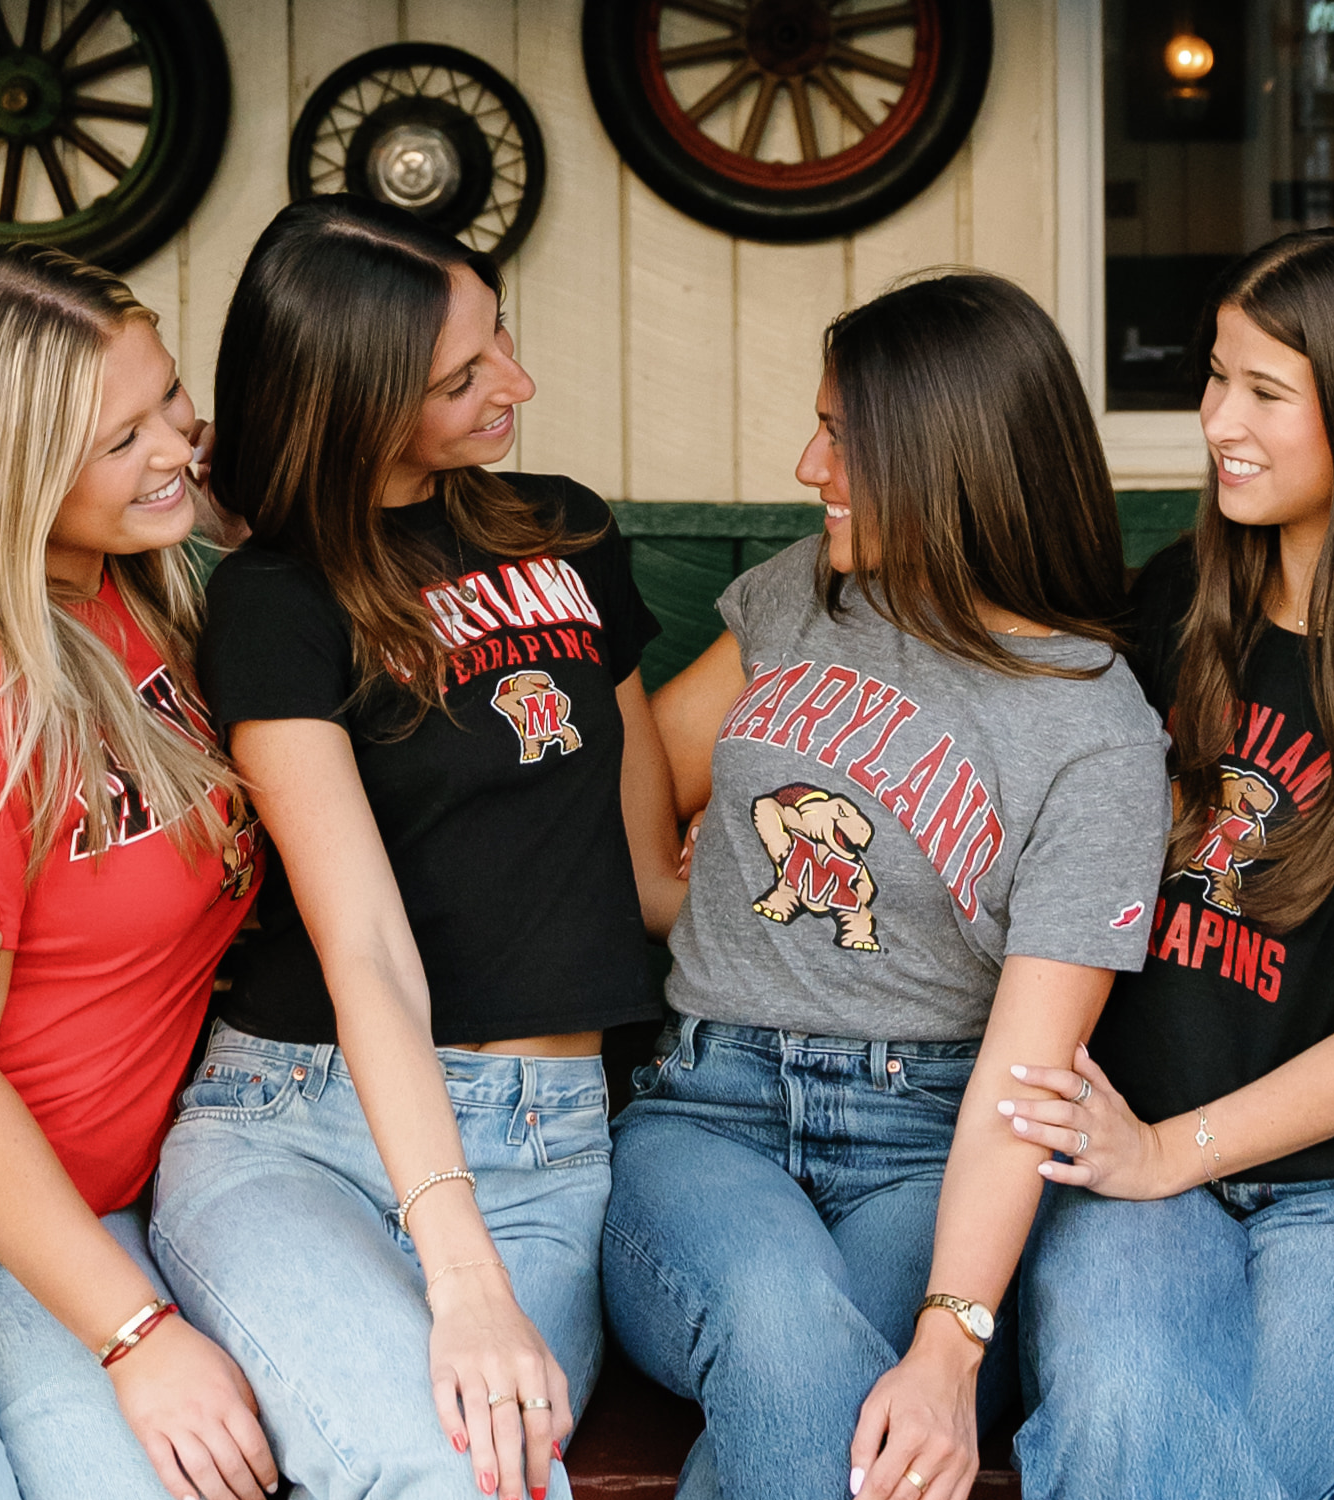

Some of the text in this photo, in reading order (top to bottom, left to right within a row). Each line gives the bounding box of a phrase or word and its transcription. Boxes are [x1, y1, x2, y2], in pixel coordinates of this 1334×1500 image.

[441, 627, 602, 695] ERRAPINS
[521, 690, 564, 739] M
[719, 659, 1005, 923] MARYLAND
[783, 832, 864, 913] M
